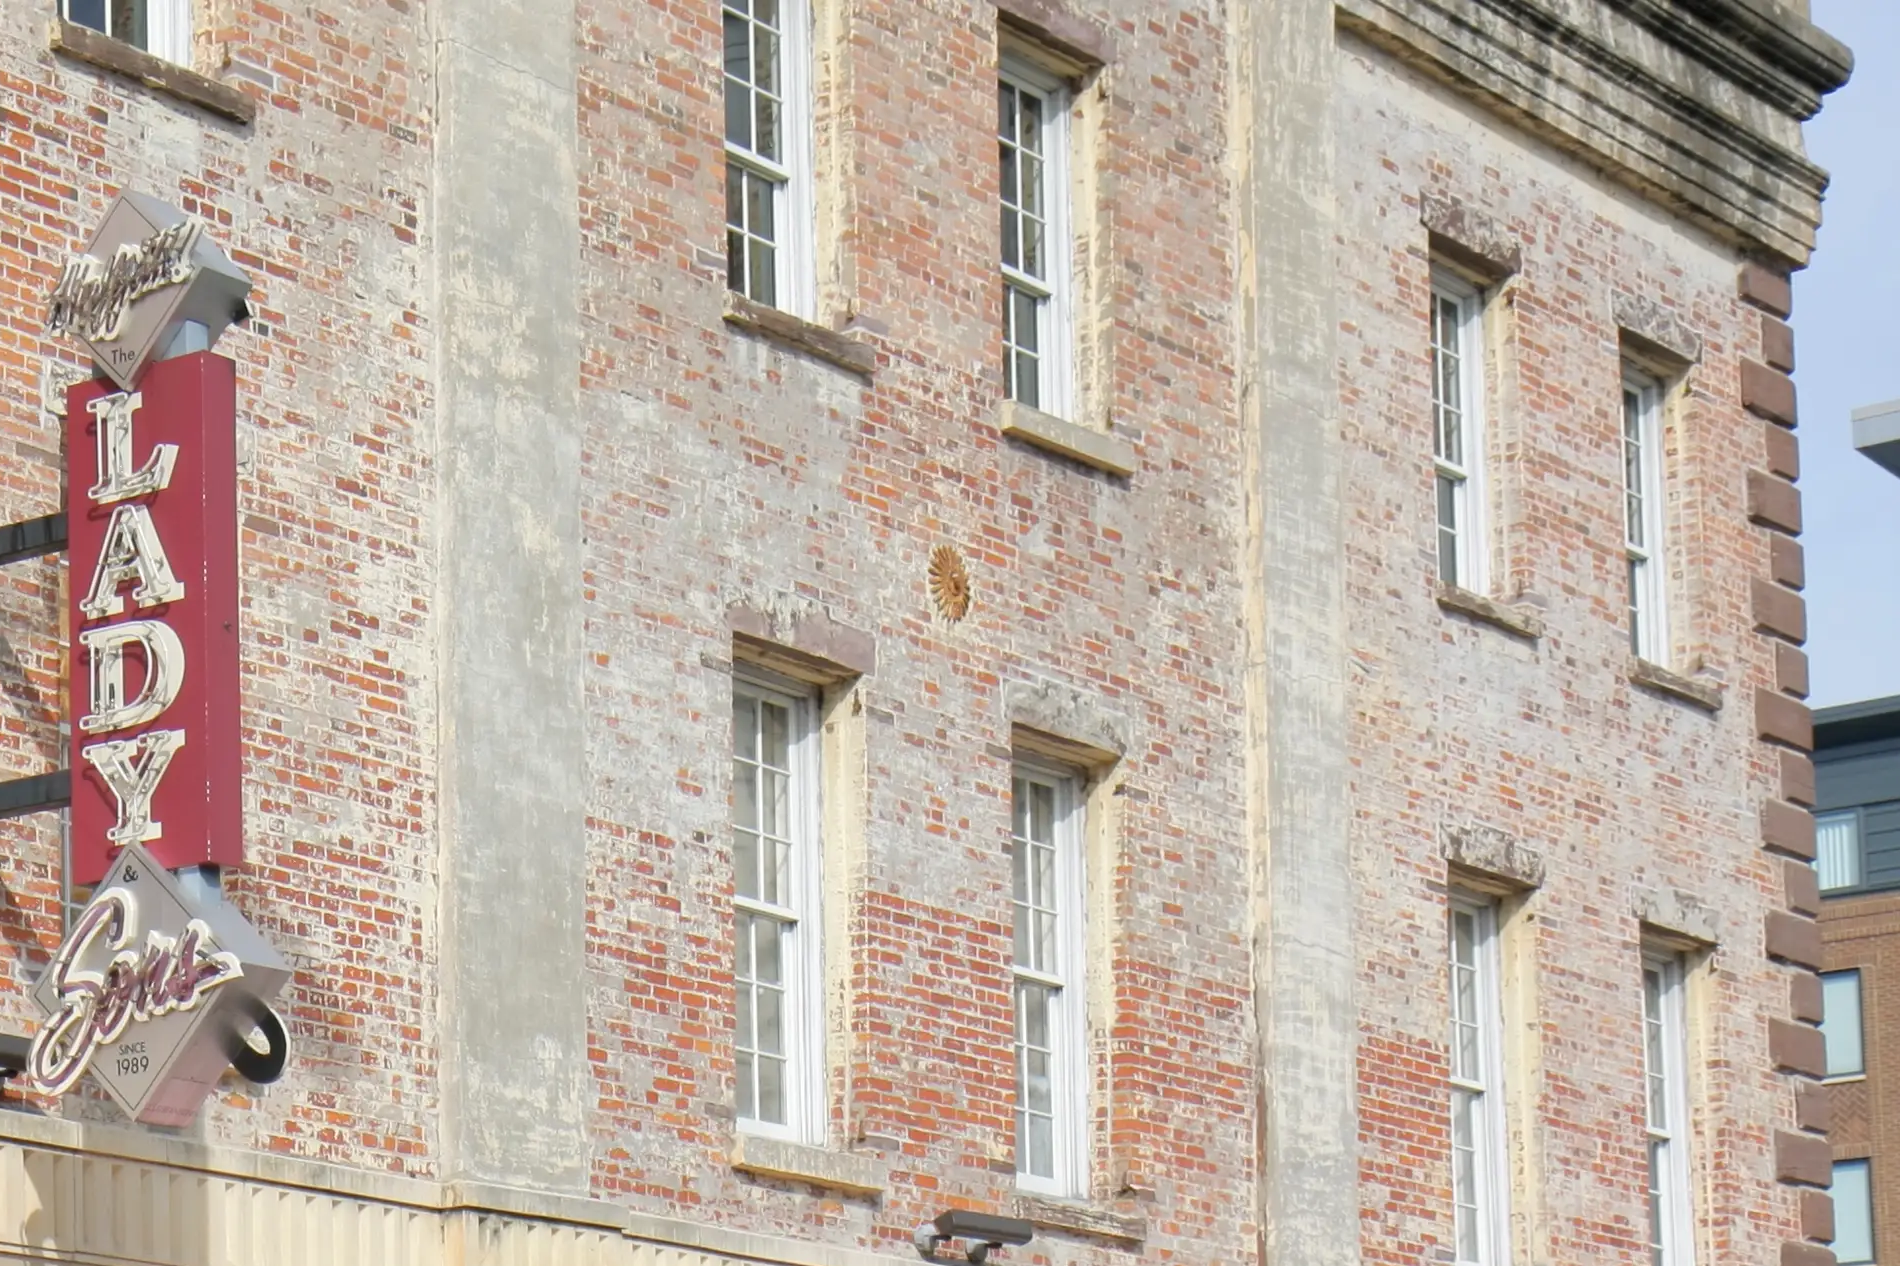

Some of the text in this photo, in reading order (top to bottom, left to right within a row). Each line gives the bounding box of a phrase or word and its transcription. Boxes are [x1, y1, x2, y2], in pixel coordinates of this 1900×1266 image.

[110, 347, 136, 367] The
[77, 390, 188, 845] LADY
[122, 864, 140, 884] &
[27, 886, 245, 1096] Sons
[118, 1041, 146, 1056] SINCE
[116, 1055, 150, 1077] 1989
